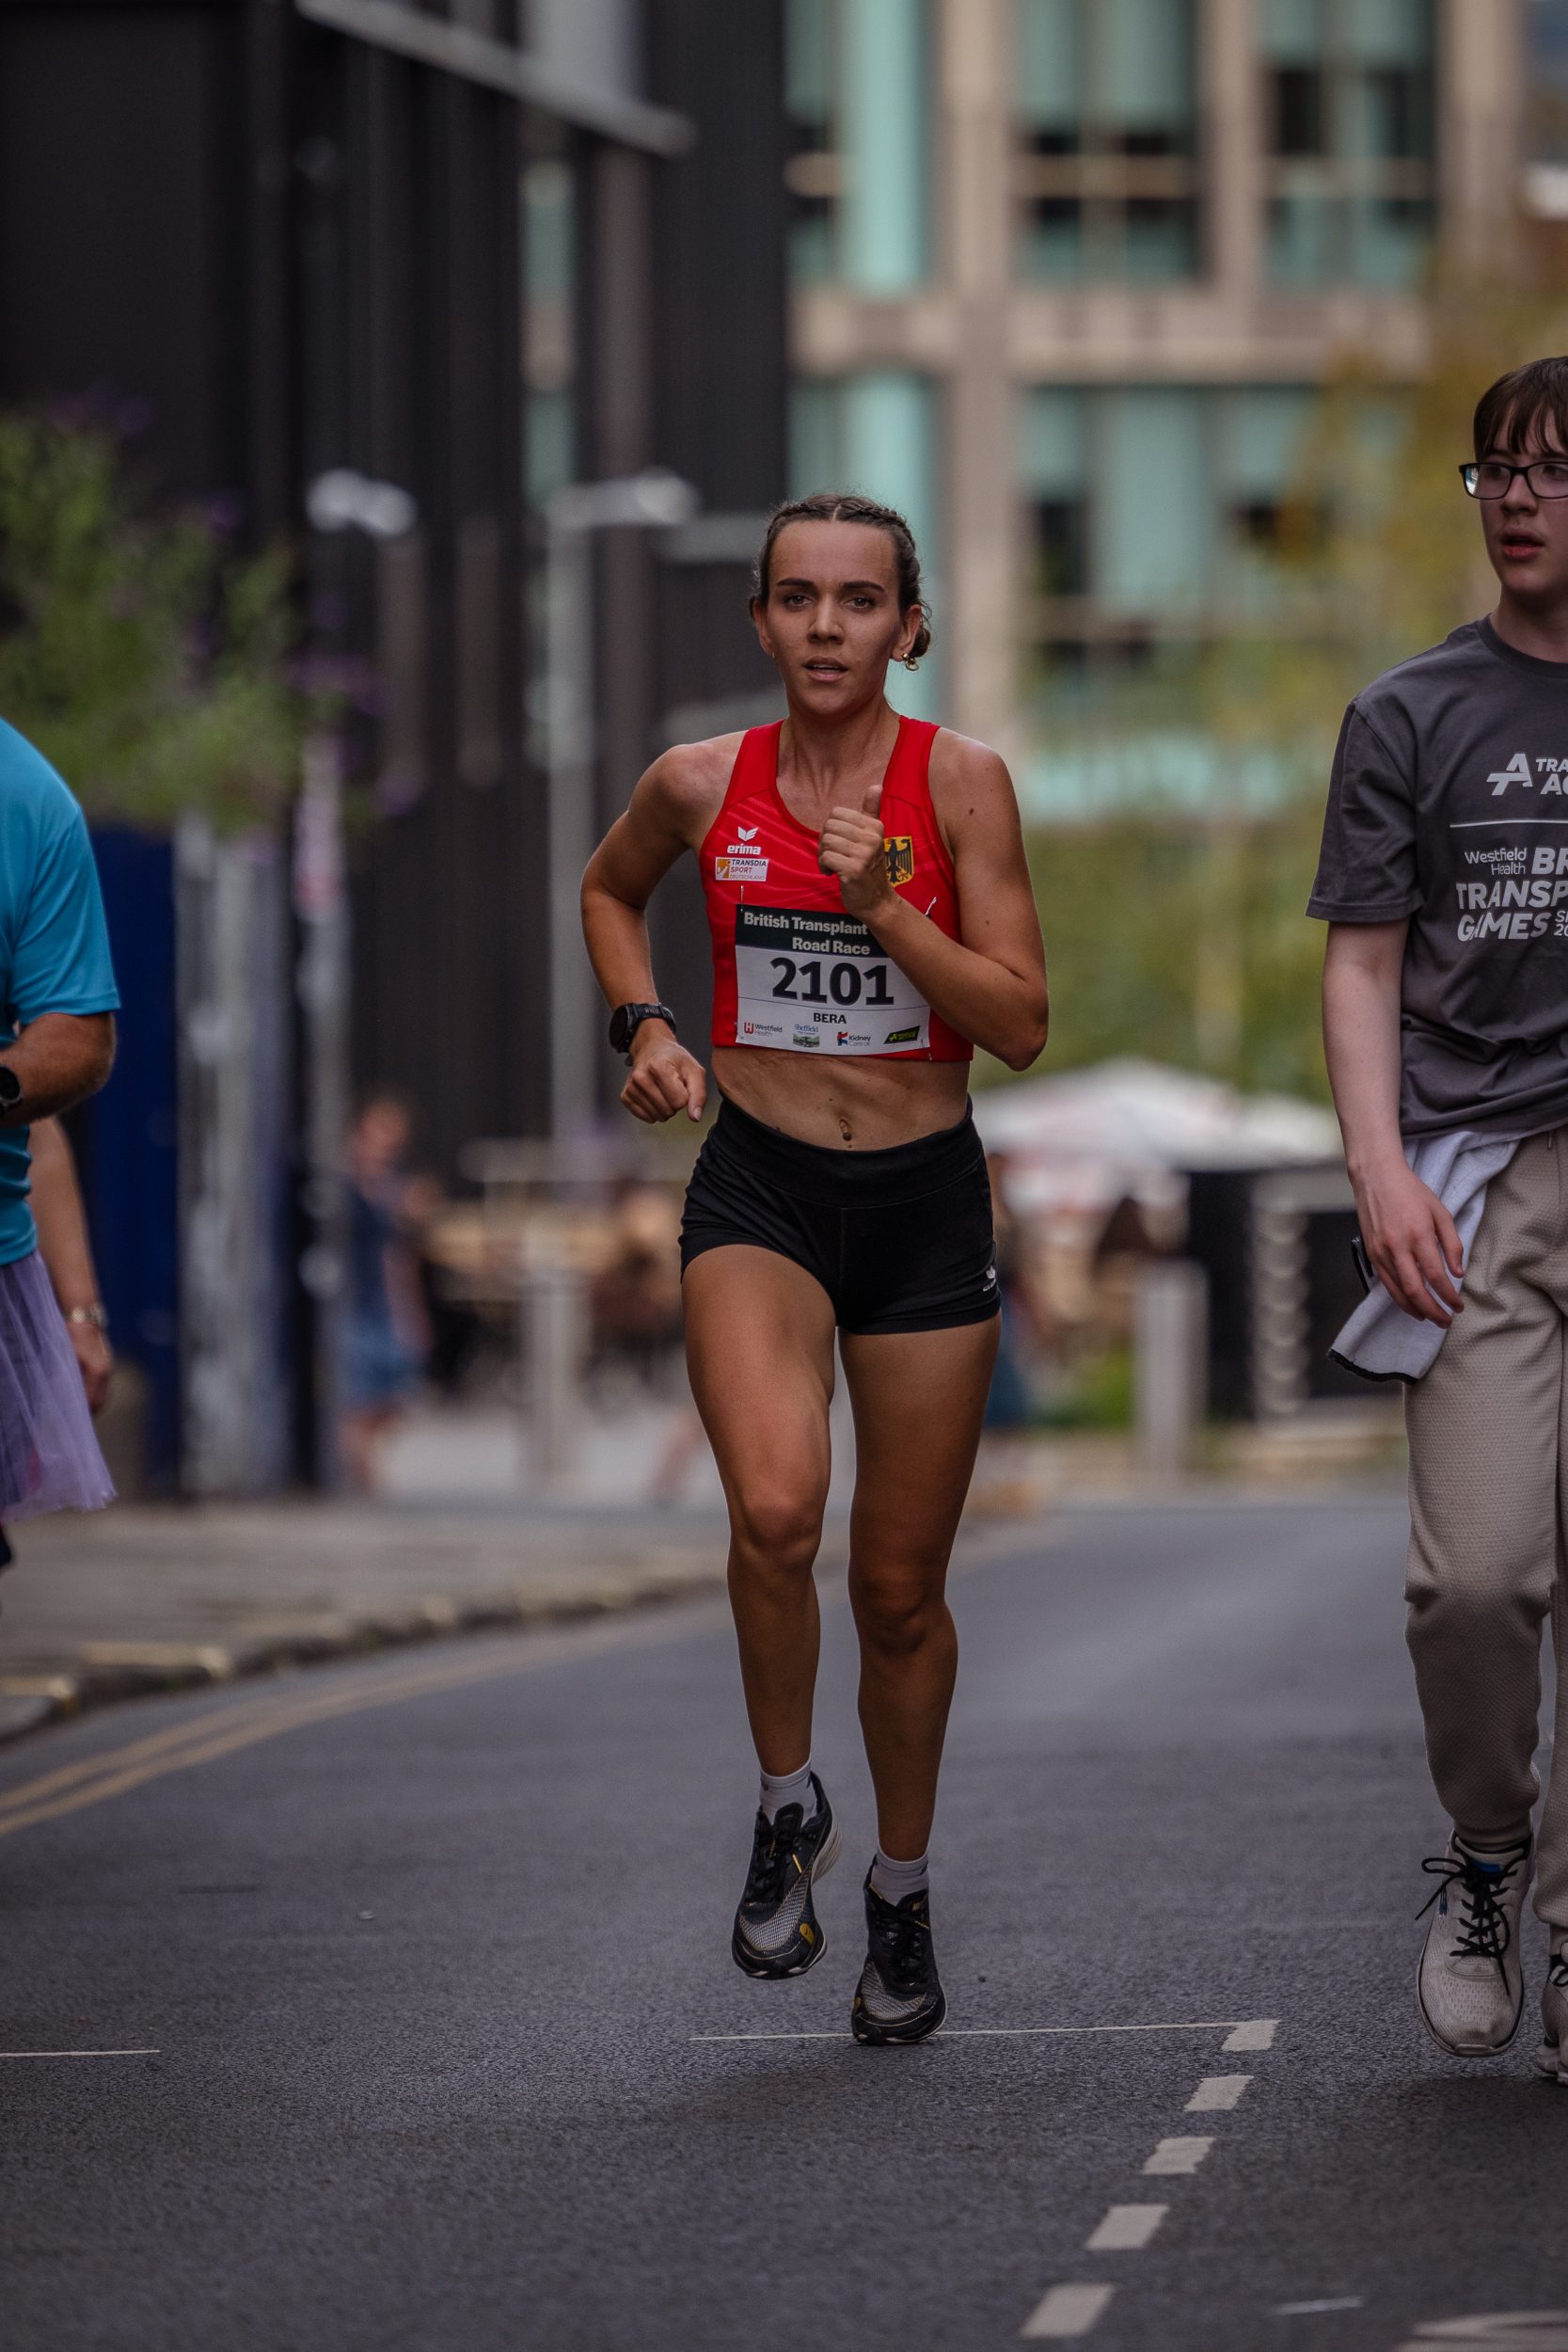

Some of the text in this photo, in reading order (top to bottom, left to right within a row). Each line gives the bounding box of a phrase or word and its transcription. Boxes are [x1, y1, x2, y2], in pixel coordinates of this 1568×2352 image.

[727, 843, 761, 855] erima
[1464, 848, 1528, 866] Westfield
[1491, 862, 1526, 876] Health
[743, 912, 869, 936] British Transplant
[792, 936, 871, 956] Road Race
[769, 957, 895, 1007] 2101
[813, 1012, 847, 1025] BERA
[755, 1023, 784, 1033] Westfield
